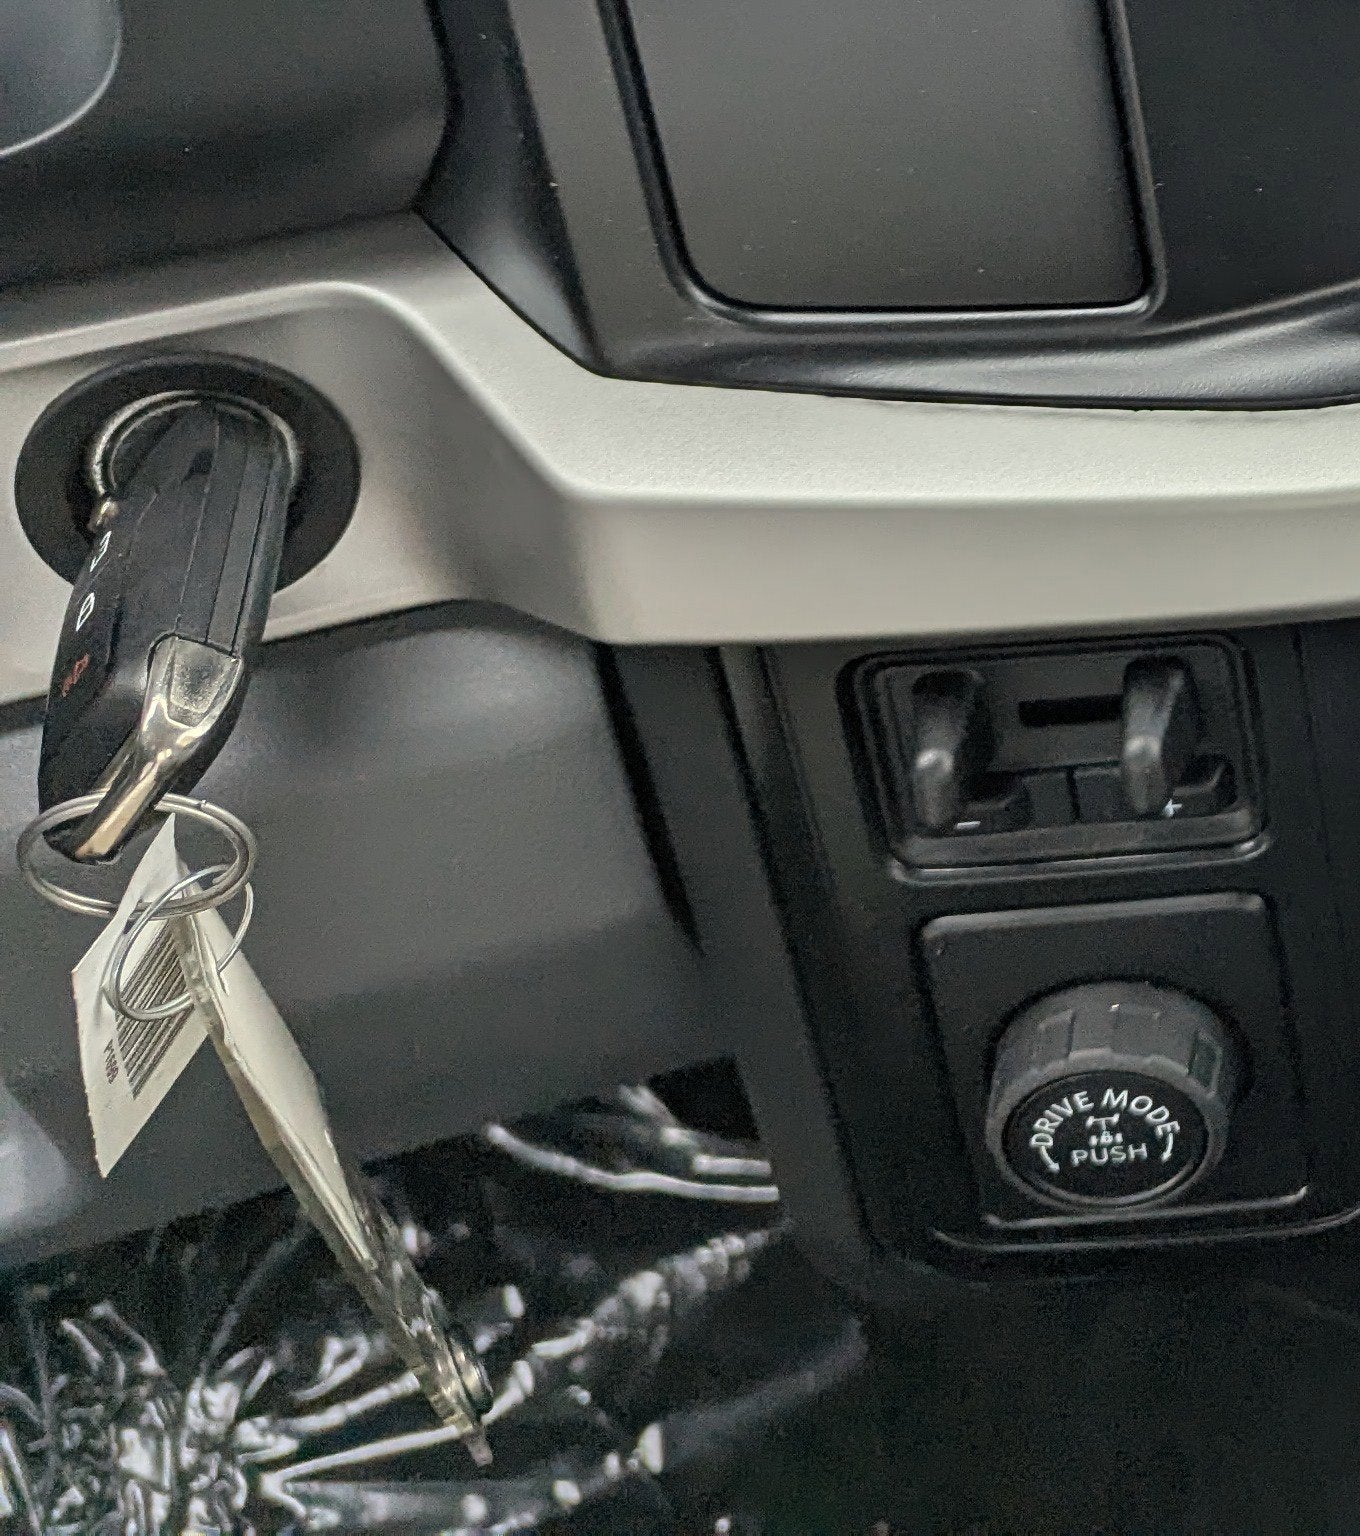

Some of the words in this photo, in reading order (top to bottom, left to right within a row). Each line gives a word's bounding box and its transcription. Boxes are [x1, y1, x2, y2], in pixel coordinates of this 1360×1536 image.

[1029, 1090, 1095, 1149] DRIVE
[1100, 1087, 1182, 1140] MODE
[1070, 1141, 1149, 1169] PUSH
